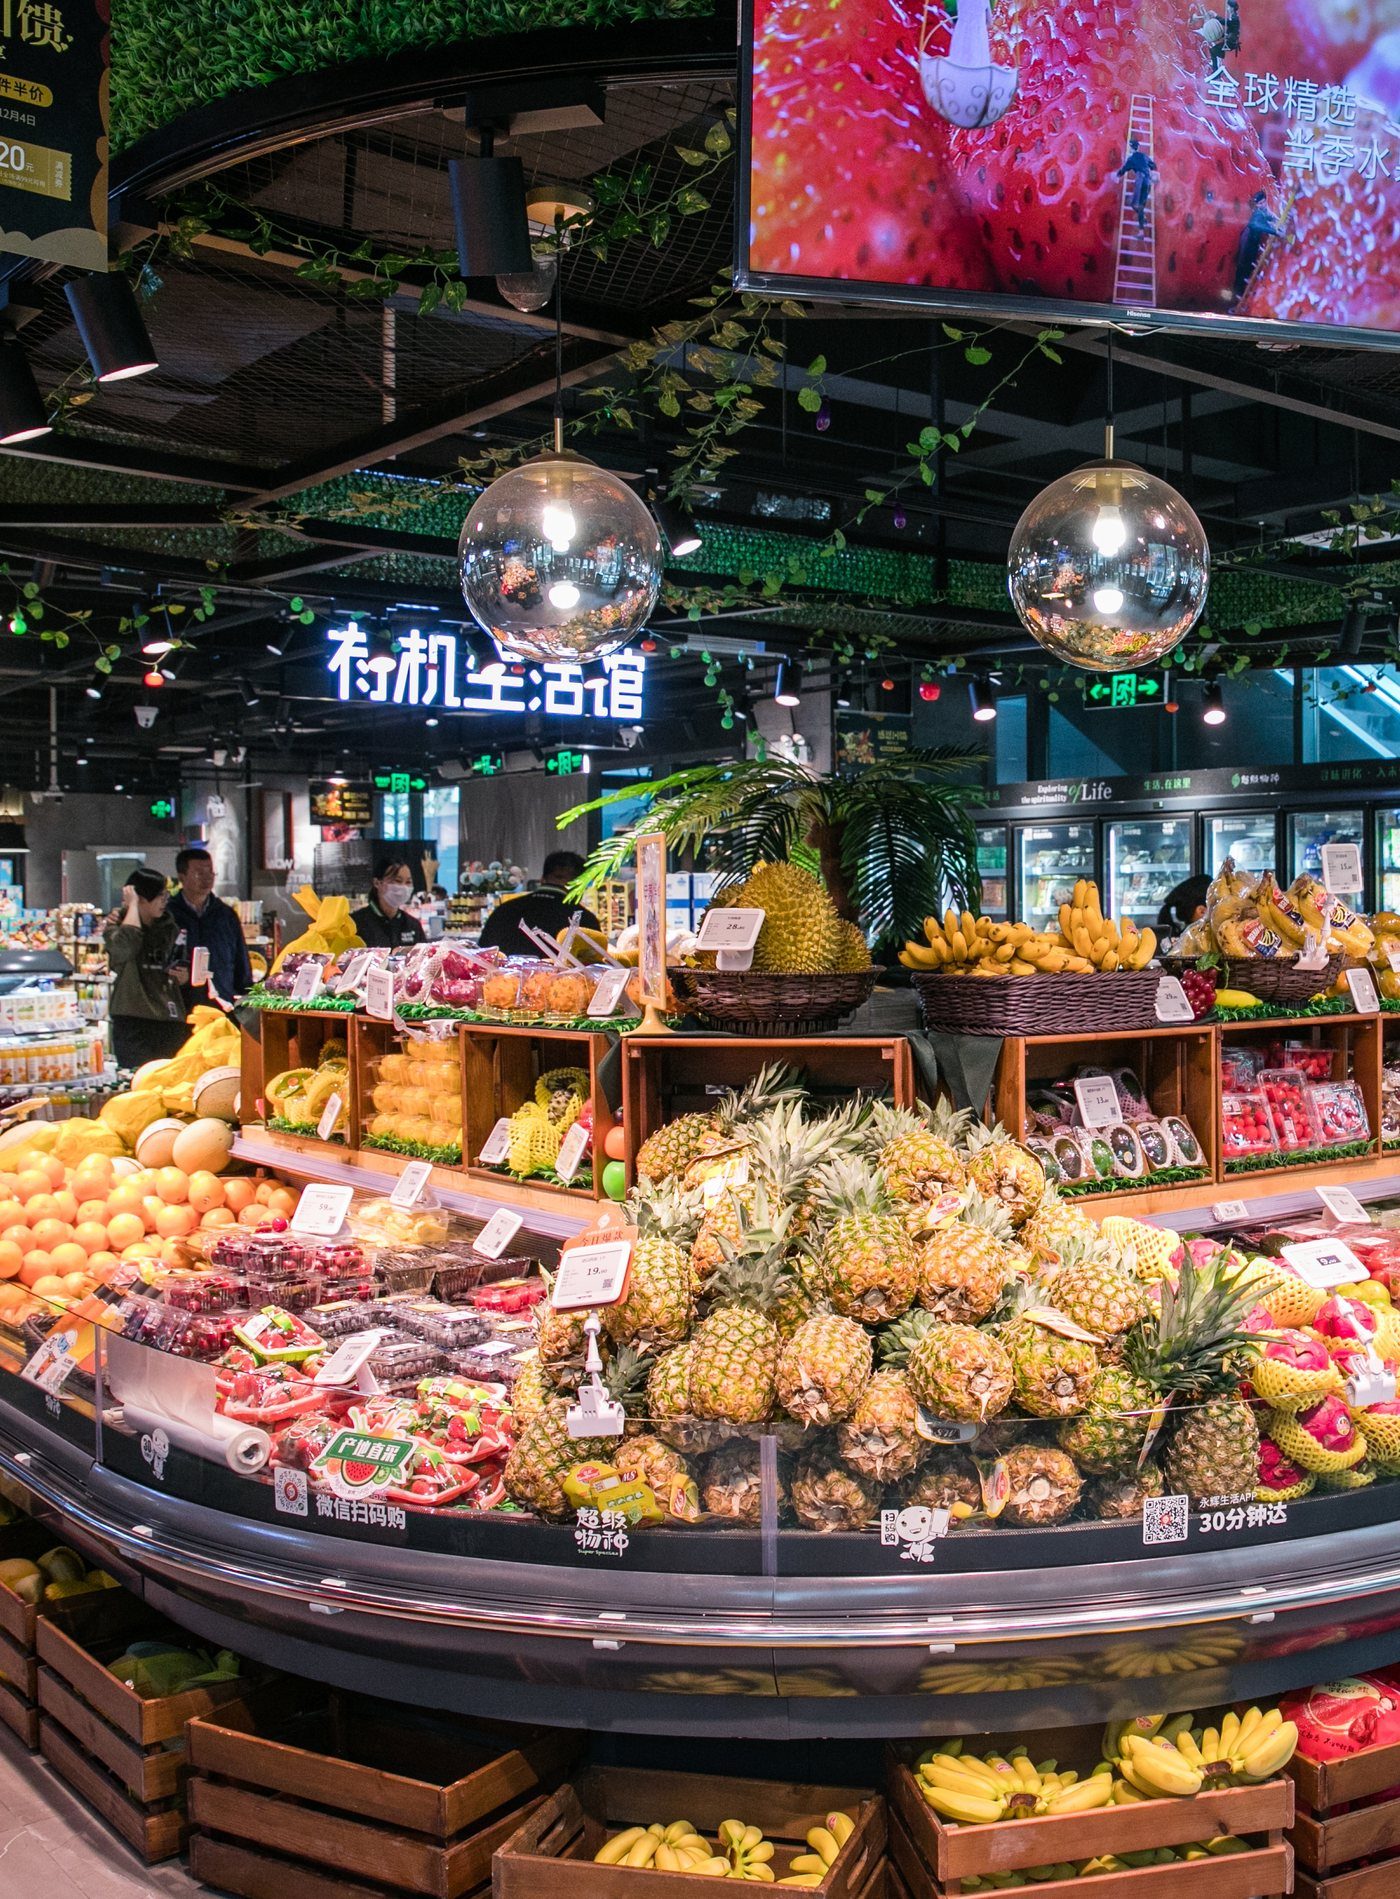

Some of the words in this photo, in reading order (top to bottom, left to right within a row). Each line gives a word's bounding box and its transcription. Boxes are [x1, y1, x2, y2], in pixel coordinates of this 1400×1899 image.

[1204, 65, 1357, 127] 全球精选
[1282, 128, 1400, 182] 当季水
[1127, 310, 1151, 318] Hisense
[328, 622, 646, 719] 有机生活馆
[1038, 784, 1068, 794] Exploring
[1081, 781, 1112, 801] Life
[338, 1437, 401, 1463] 产地直采
[316, 1494, 406, 1530] 微信扫码购
[1199, 1491, 1258, 1508] 永辉生活APP
[576, 1506, 627, 1530] 超级
[884, 1512, 897, 1543] 扫码购
[1199, 1501, 1288, 1533] 30分钟达
[574, 1529, 629, 1557] 物种
